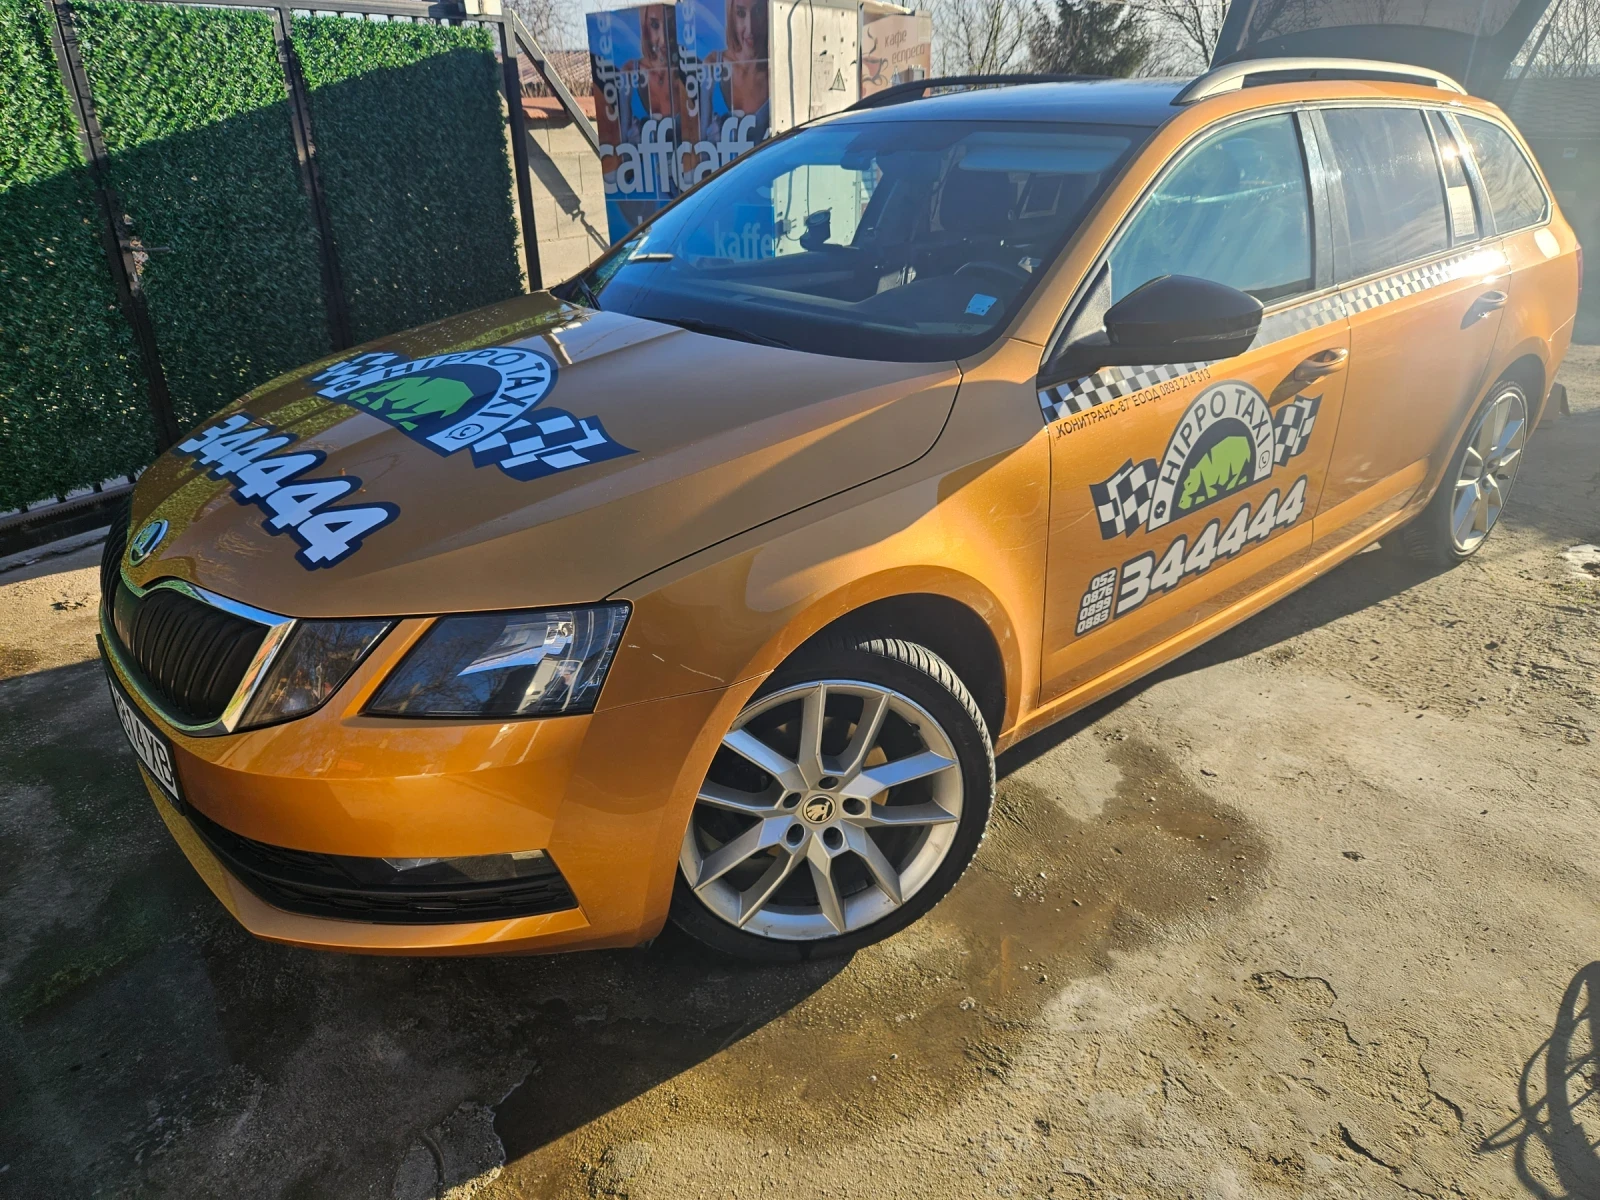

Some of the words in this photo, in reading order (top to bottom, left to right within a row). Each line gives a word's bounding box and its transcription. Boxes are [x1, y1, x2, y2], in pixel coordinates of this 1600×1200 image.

[383, 349, 526, 379] HIPPO
[477, 361, 546, 419] TAXI
[1180, 375, 1196, 389] 214
[1196, 368, 1211, 383] 313
[1161, 390, 1226, 486] HIPPO
[1234, 388, 1271, 448] TAXI
[177, 414, 390, 564] 344444
[1115, 478, 1307, 615] 344444
[1091, 569, 1117, 590] 052
[1082, 583, 1115, 607] 0876
[1079, 596, 1112, 620] 0899
[1076, 609, 1110, 633] 0883
